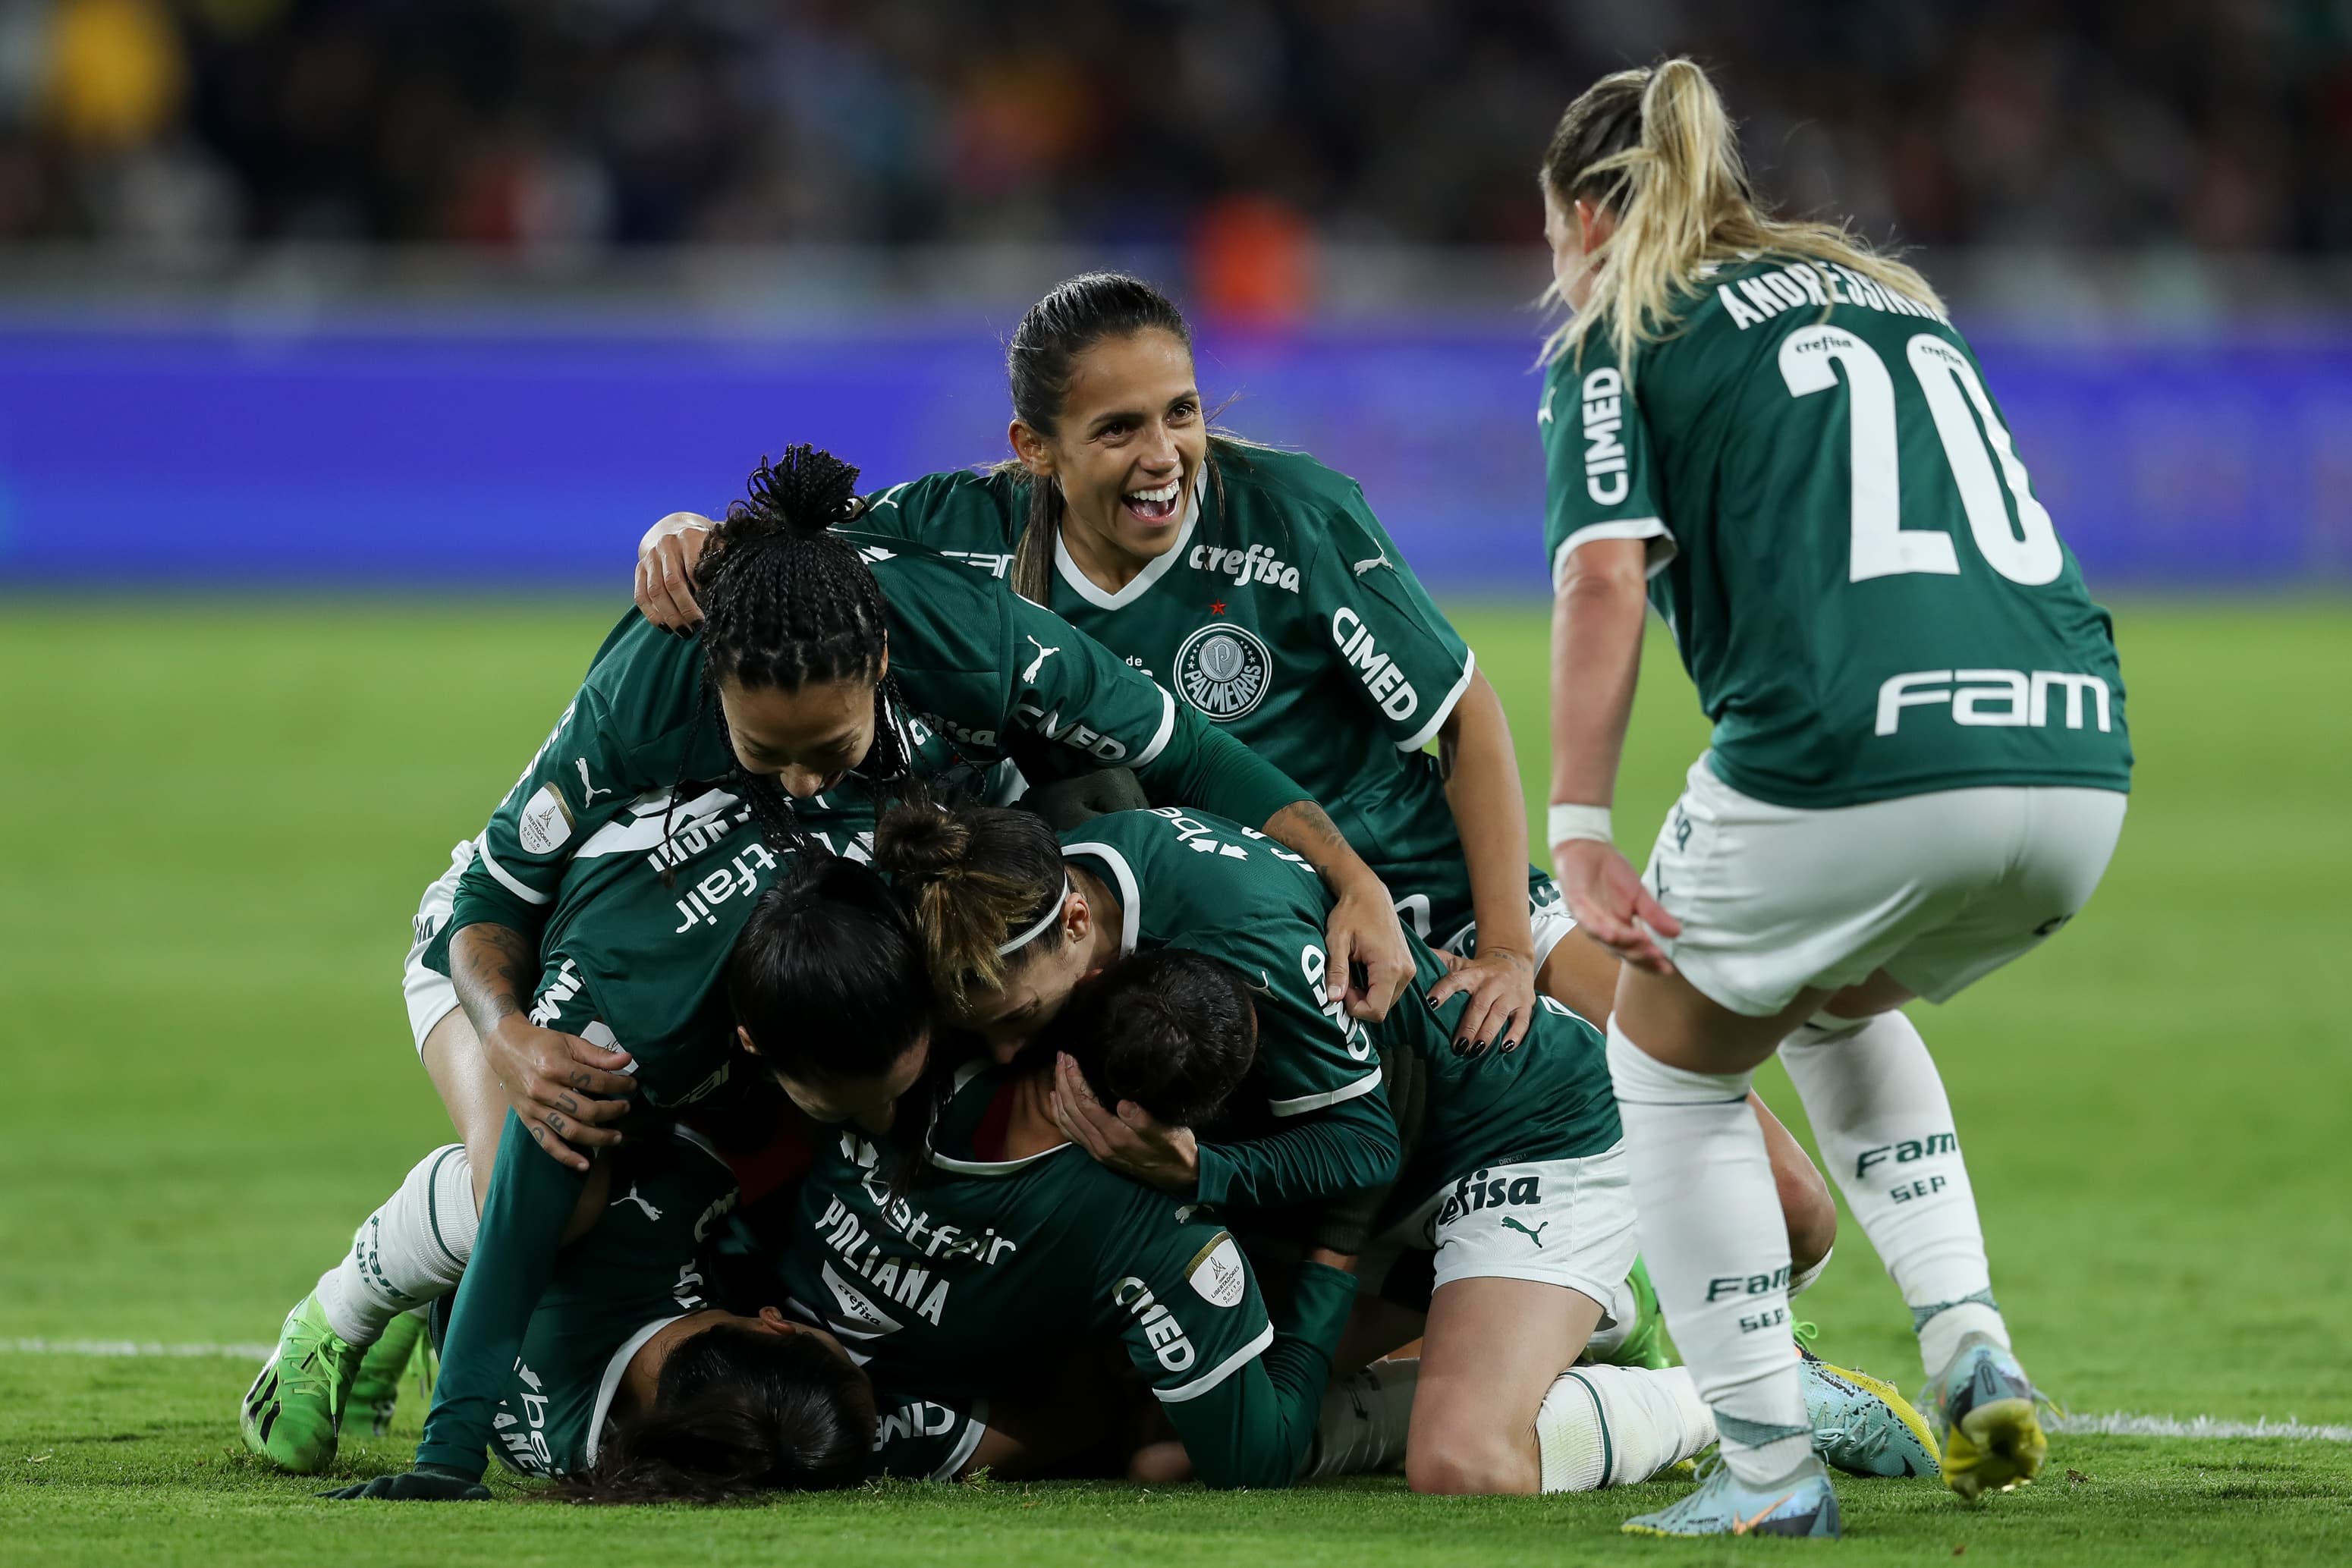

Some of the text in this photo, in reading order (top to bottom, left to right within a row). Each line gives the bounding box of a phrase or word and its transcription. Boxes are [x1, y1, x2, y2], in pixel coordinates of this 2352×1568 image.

[1795, 334, 1854, 354] crefisa
[1582, 366, 1629, 506] CIMED
[1778, 325, 2064, 586] 20
[1189, 544, 1300, 595] crefisa
[1125, 655, 1143, 666] de
[1332, 607, 1418, 721] CIMED
[1184, 665, 1261, 713] PALMEIRAS
[1875, 668, 2111, 737] Fam
[674, 833, 804, 934] tfair
[1856, 1133, 1957, 1179] Fam
[1438, 1168, 1542, 1227] efisa
[1890, 1175, 1947, 1205] SEP
[815, 1192, 950, 1327] POLIANA
[1210, 1265, 1240, 1299] LIBERTADORES
[837, 1283, 882, 1327] crefisa
[492, 1400, 552, 1479] ANE
